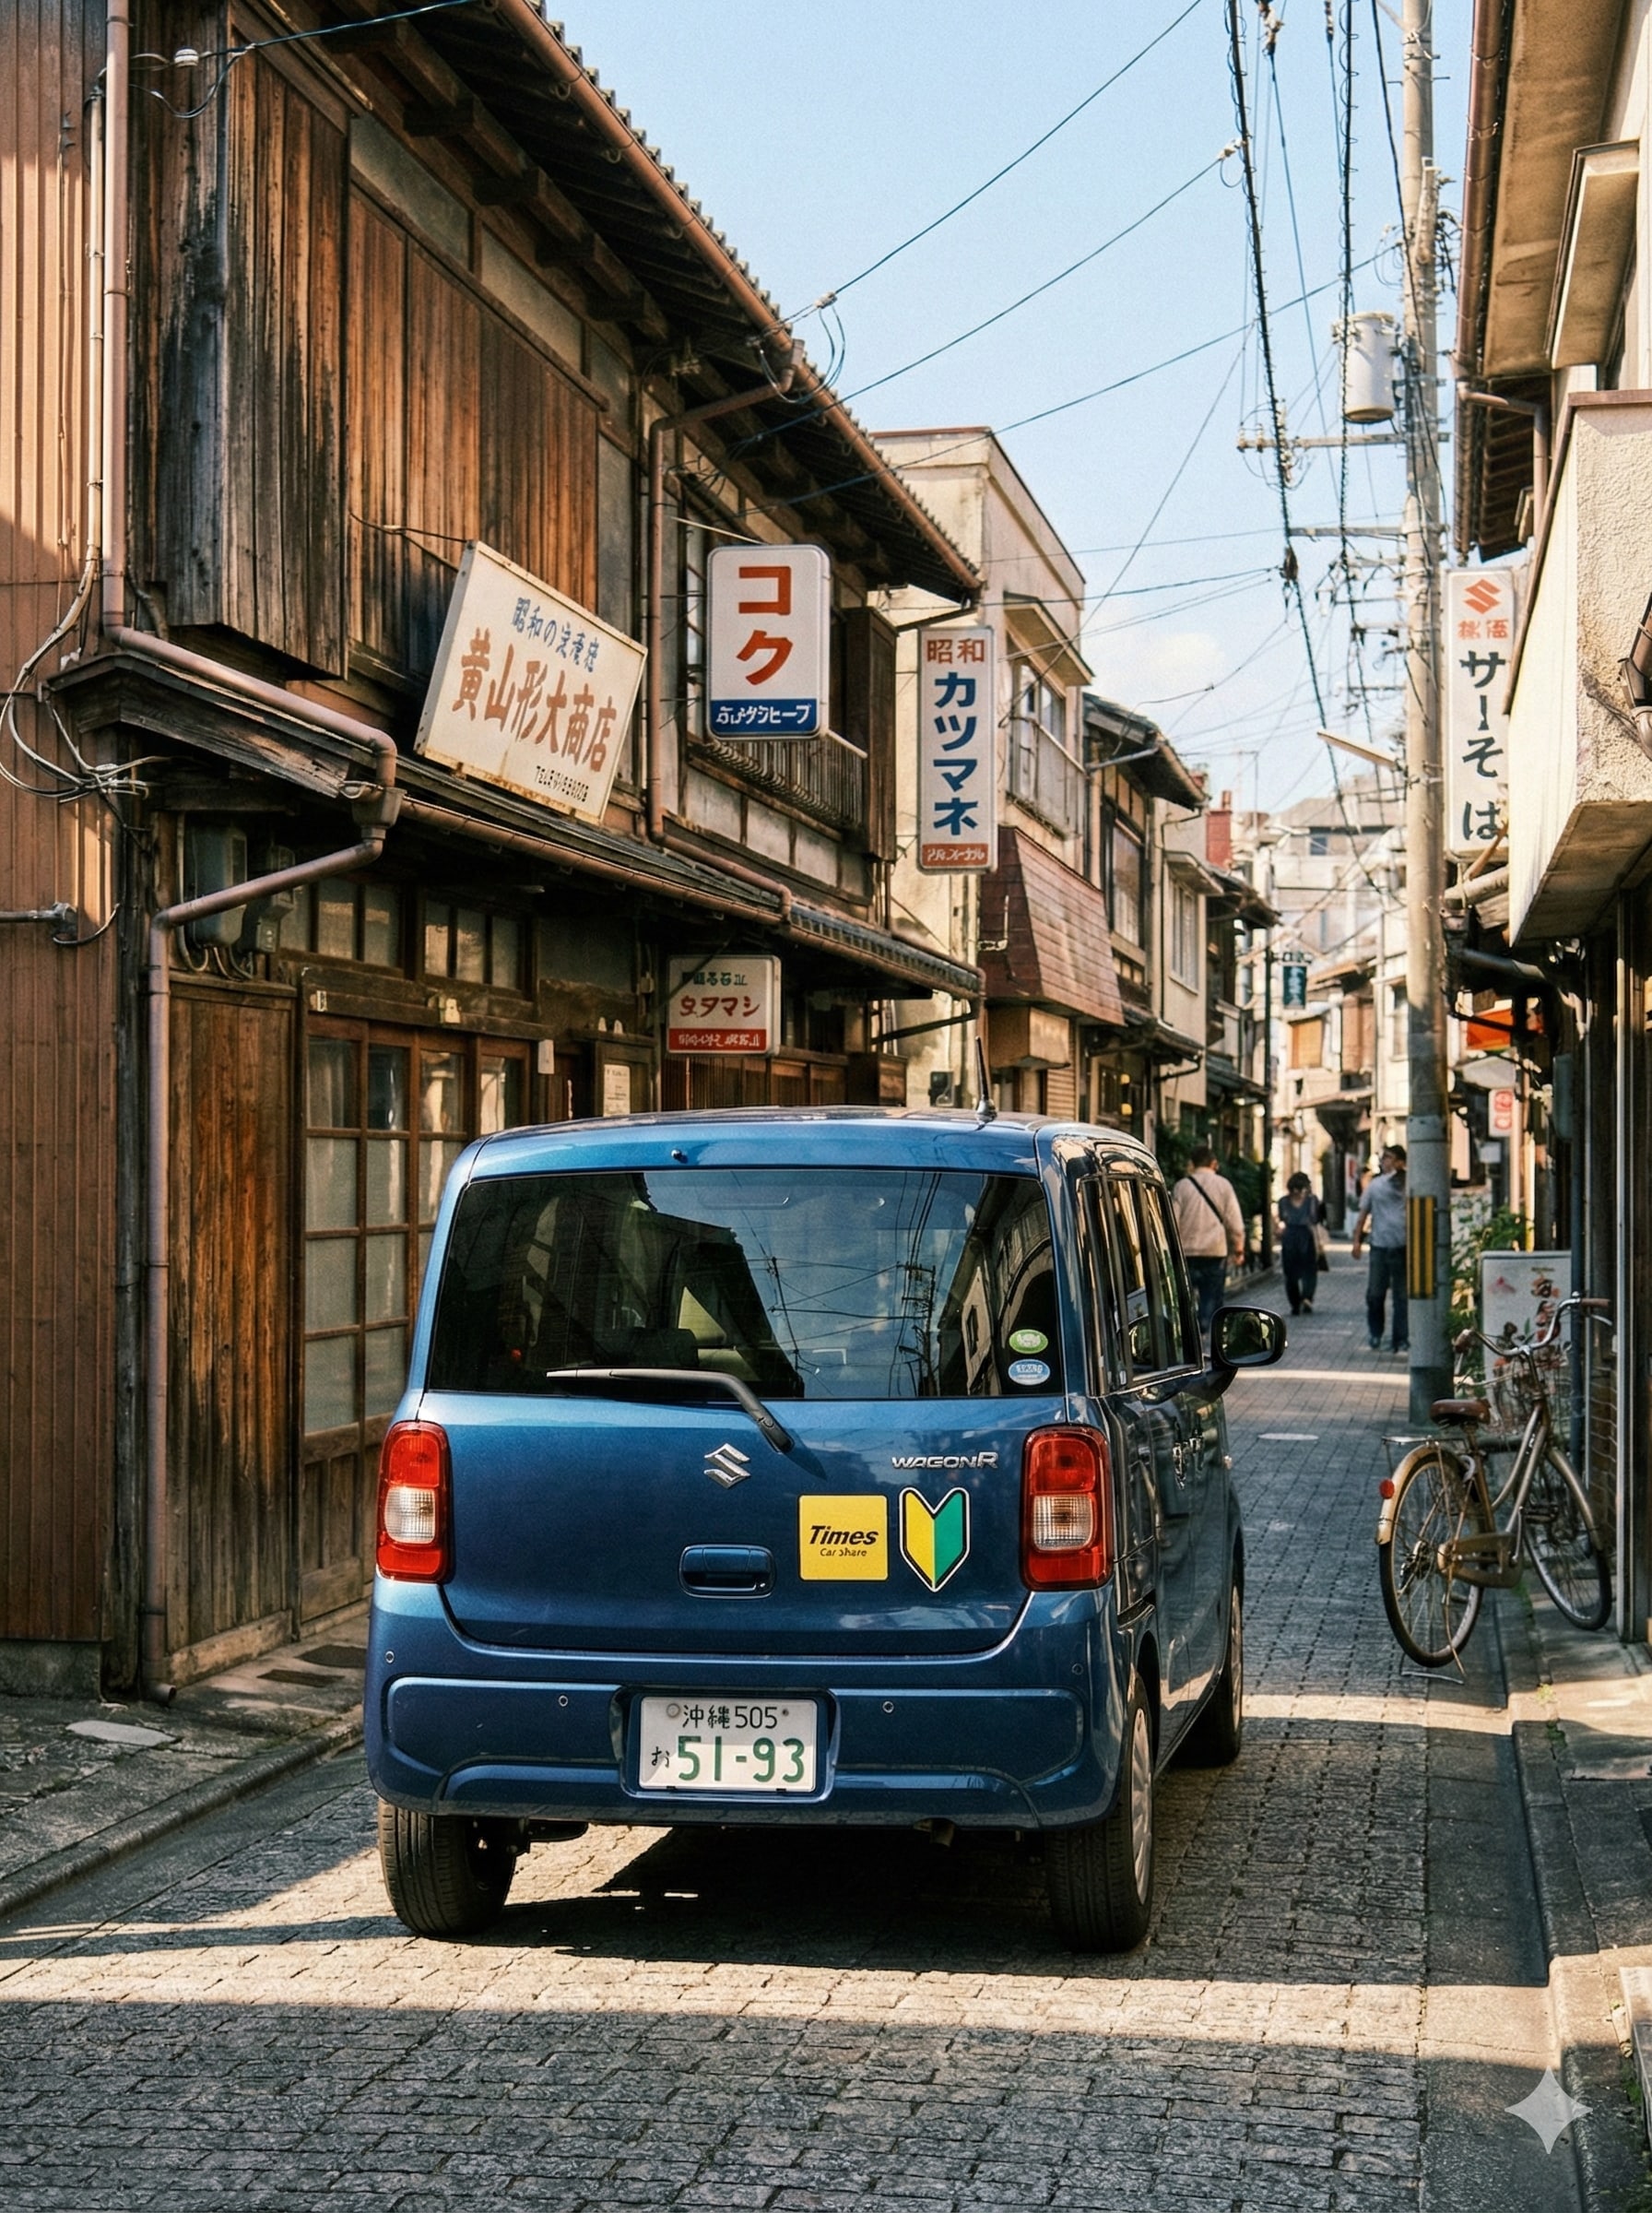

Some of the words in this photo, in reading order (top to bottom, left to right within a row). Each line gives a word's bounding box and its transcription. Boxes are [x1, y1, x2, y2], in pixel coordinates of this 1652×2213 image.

[737, 565, 794, 686] コク
[926, 638, 985, 664] 昭和
[933, 671, 979, 836] カツマネ
[809, 1525, 879, 1545] Times
[820, 1547, 836, 1557] Car
[678, 1735, 805, 1783] 51-93
